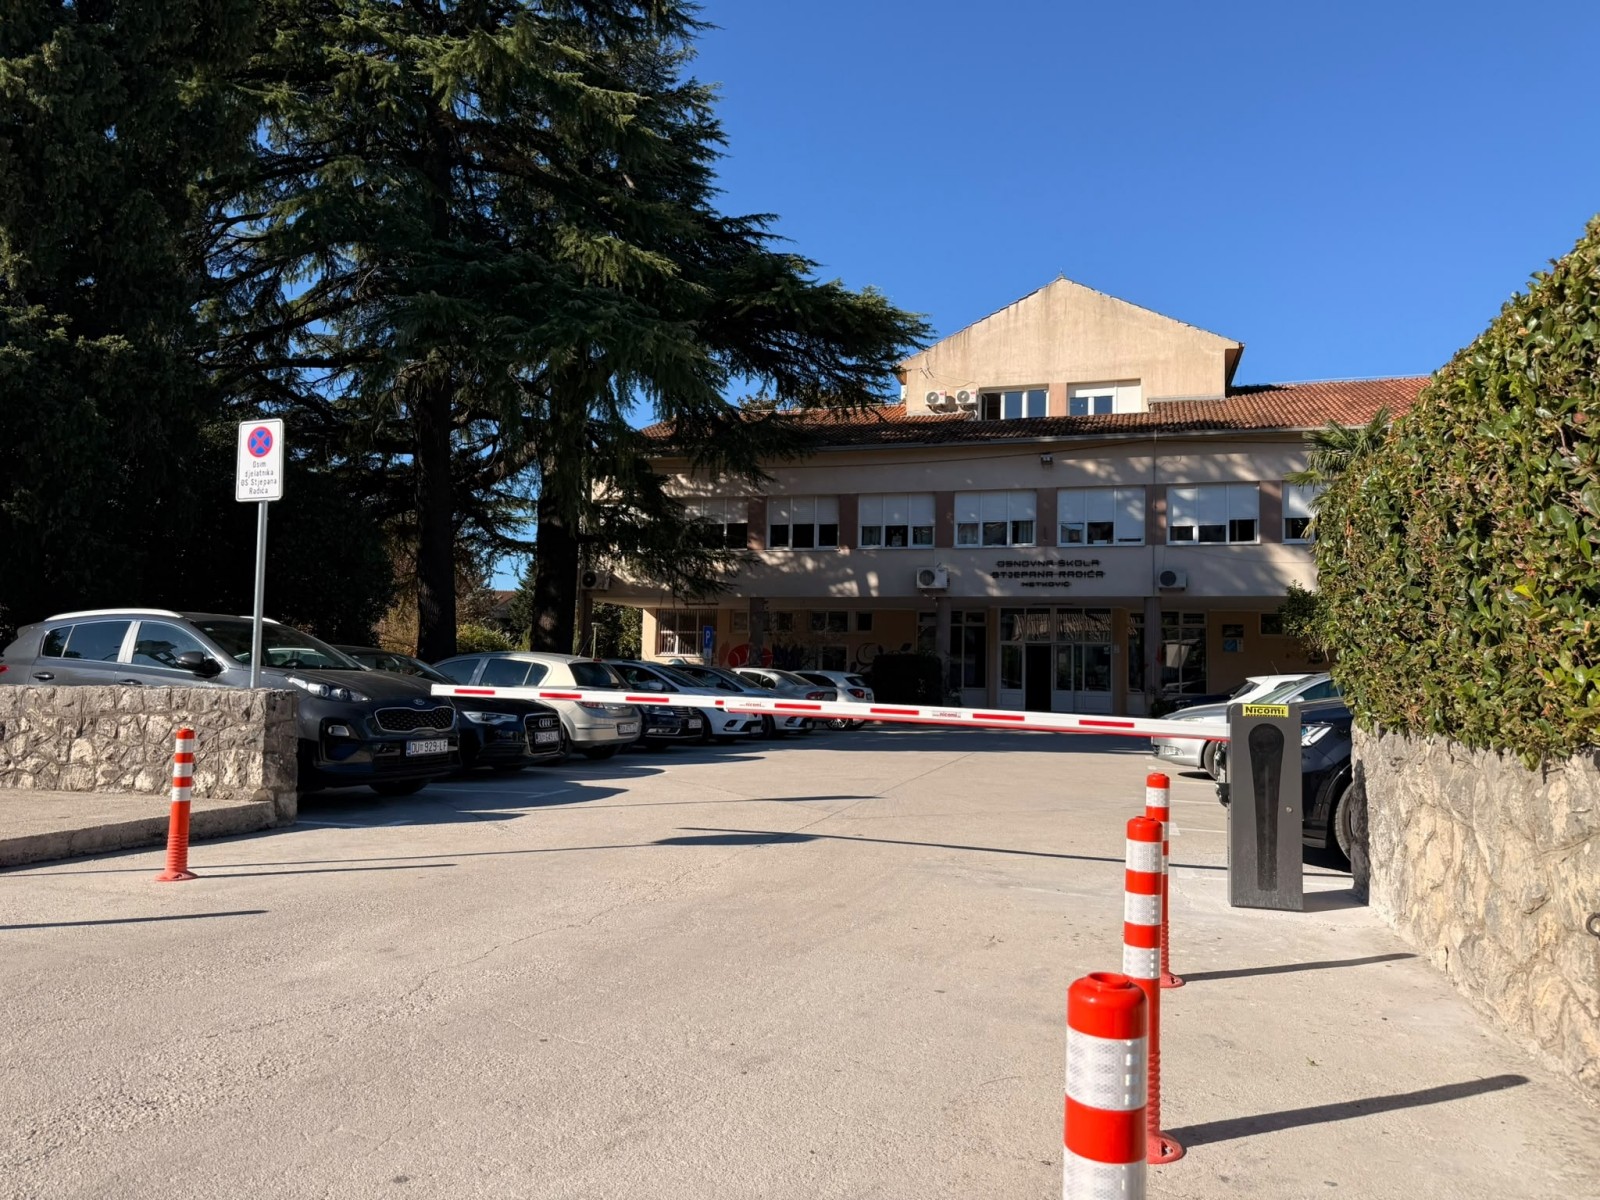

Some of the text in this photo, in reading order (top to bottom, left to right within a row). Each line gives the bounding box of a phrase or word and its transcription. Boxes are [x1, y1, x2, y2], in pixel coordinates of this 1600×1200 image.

[991, 570, 1104, 579] STJEPANA RADIĆA
[1245, 706, 1284, 715] Nicomi
